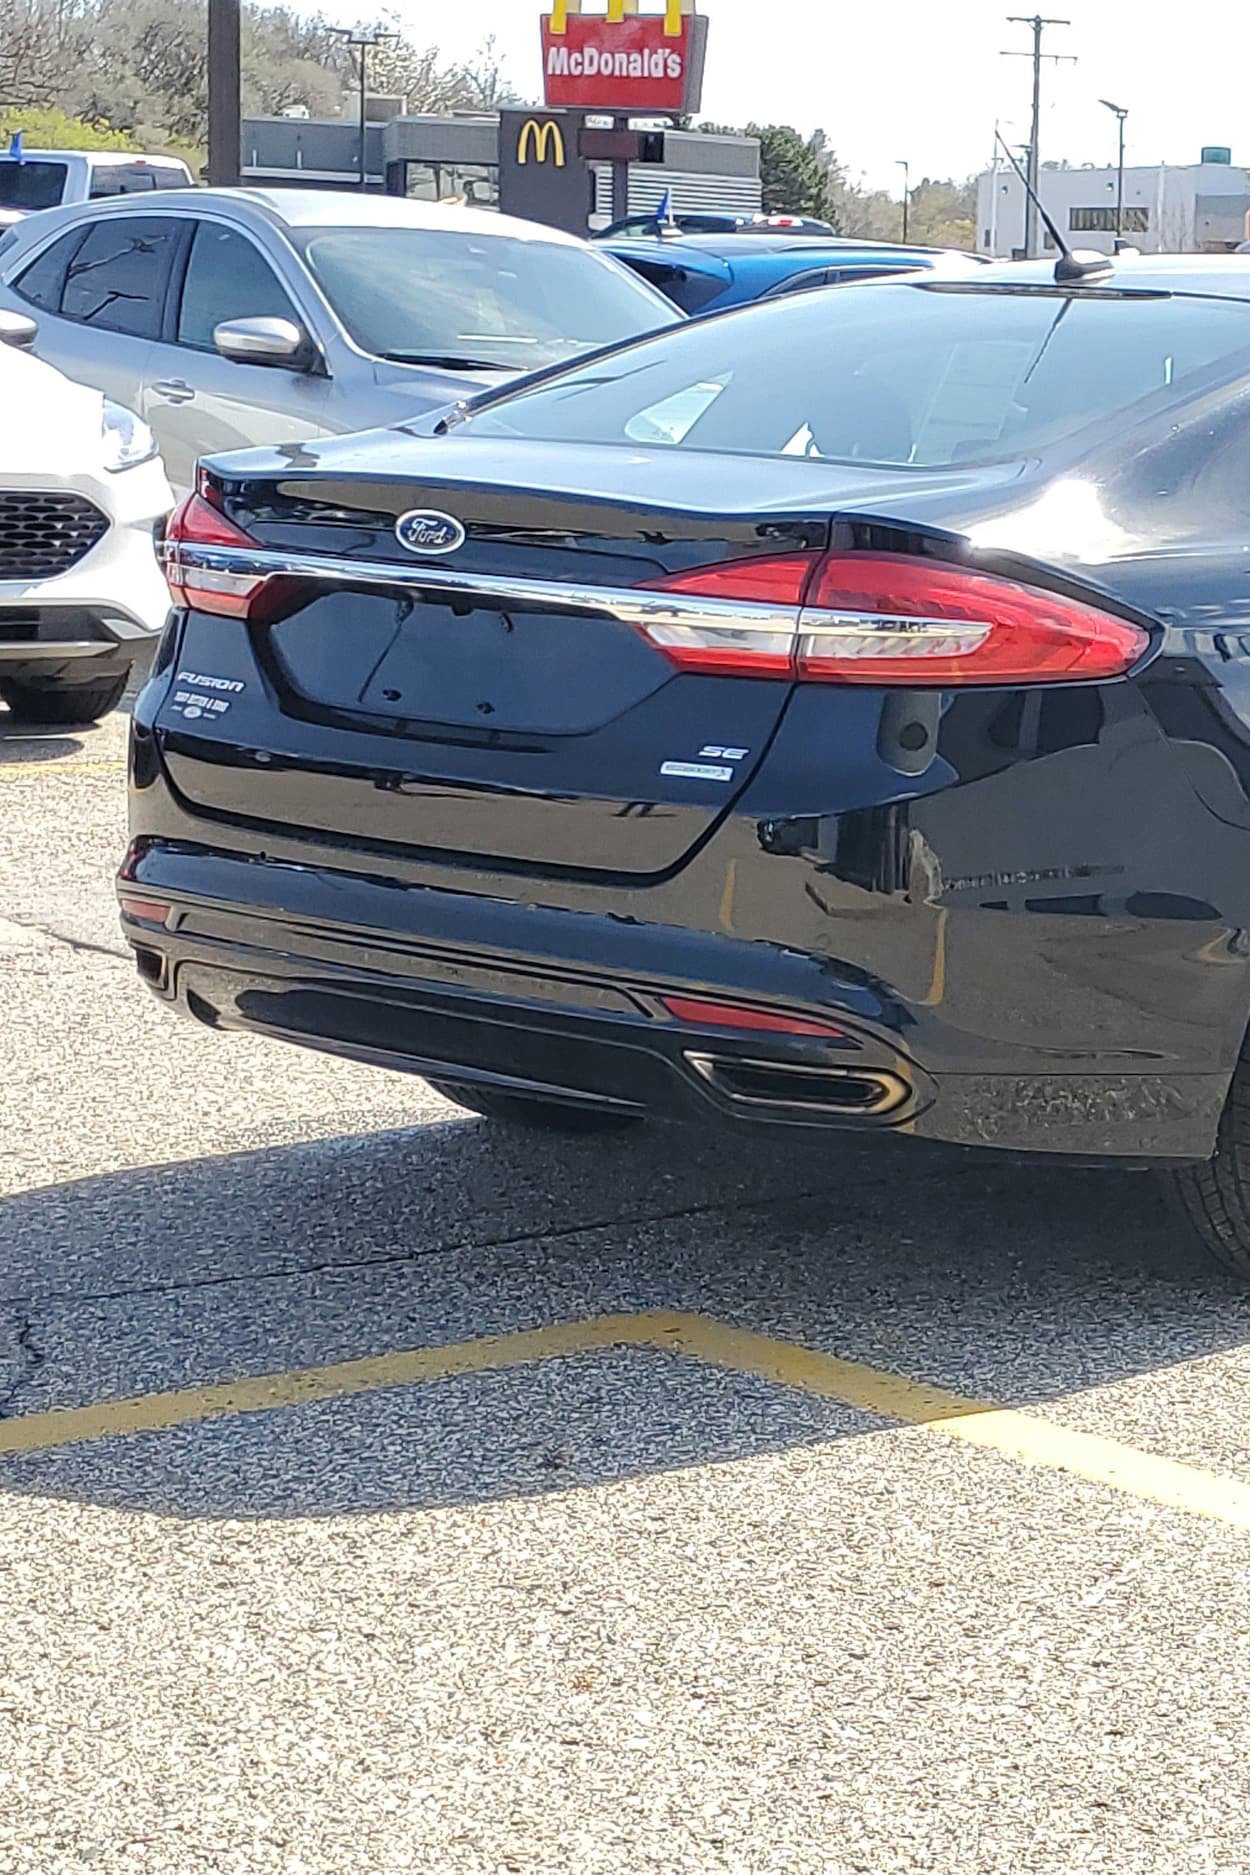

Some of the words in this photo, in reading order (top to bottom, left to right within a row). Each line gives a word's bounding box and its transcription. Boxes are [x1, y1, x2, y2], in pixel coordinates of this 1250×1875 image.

[547, 46, 682, 79] McDonald's
[408, 518, 448, 544] Ford
[178, 671, 245, 692] FUSION
[699, 745, 750, 760] SE
